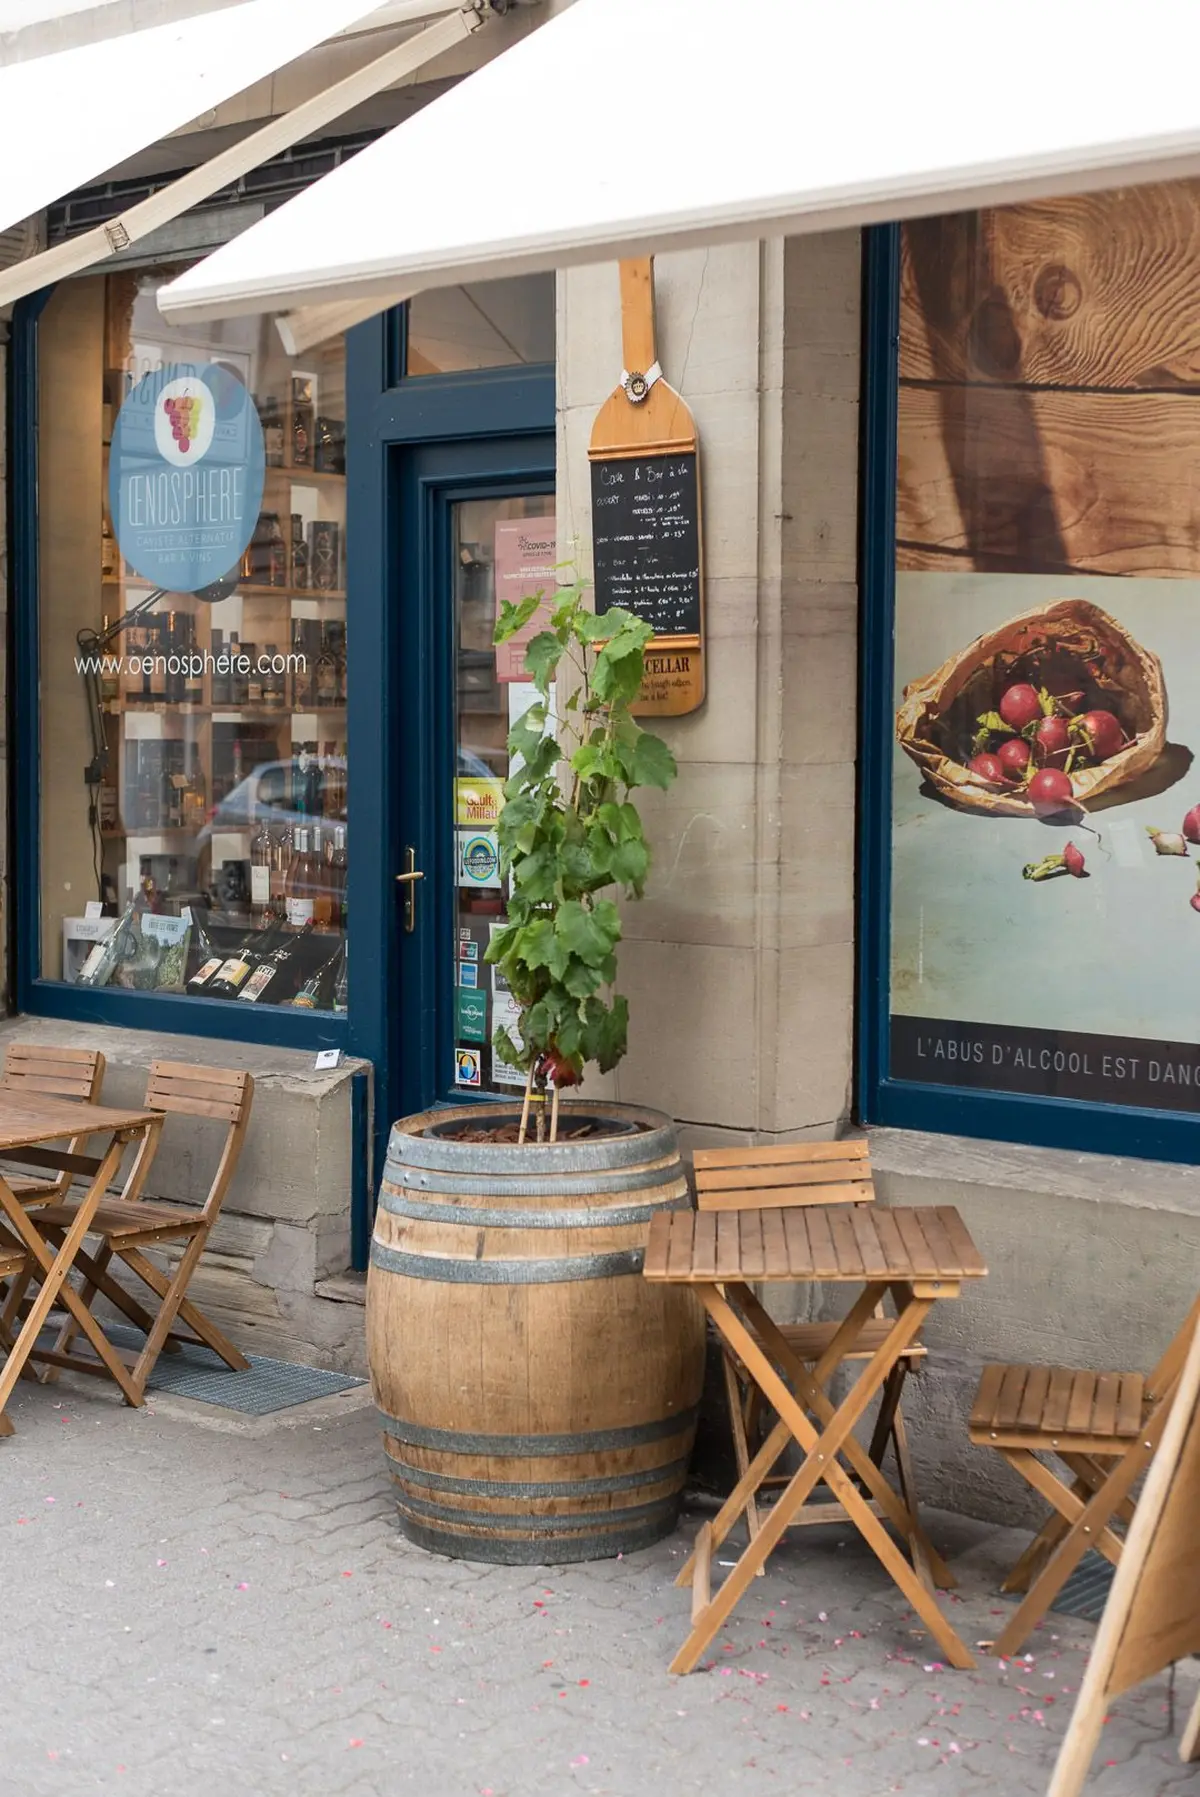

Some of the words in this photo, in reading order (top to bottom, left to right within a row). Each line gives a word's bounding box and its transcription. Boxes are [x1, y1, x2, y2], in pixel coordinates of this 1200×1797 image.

[128, 467, 243, 526] ŒNOSPHERE
[136, 534, 173, 547] CAVISTE
[158, 554, 176, 563] BAR
[189, 552, 212, 562] VINS
[73, 649, 307, 680] www.oenosphere.com
[645, 656, 690, 674] CELLAR
[917, 1036, 984, 1063] L'ABUS
[992, 1044, 1093, 1075] D'ALCOOL
[1102, 1056, 1140, 1079] EST
